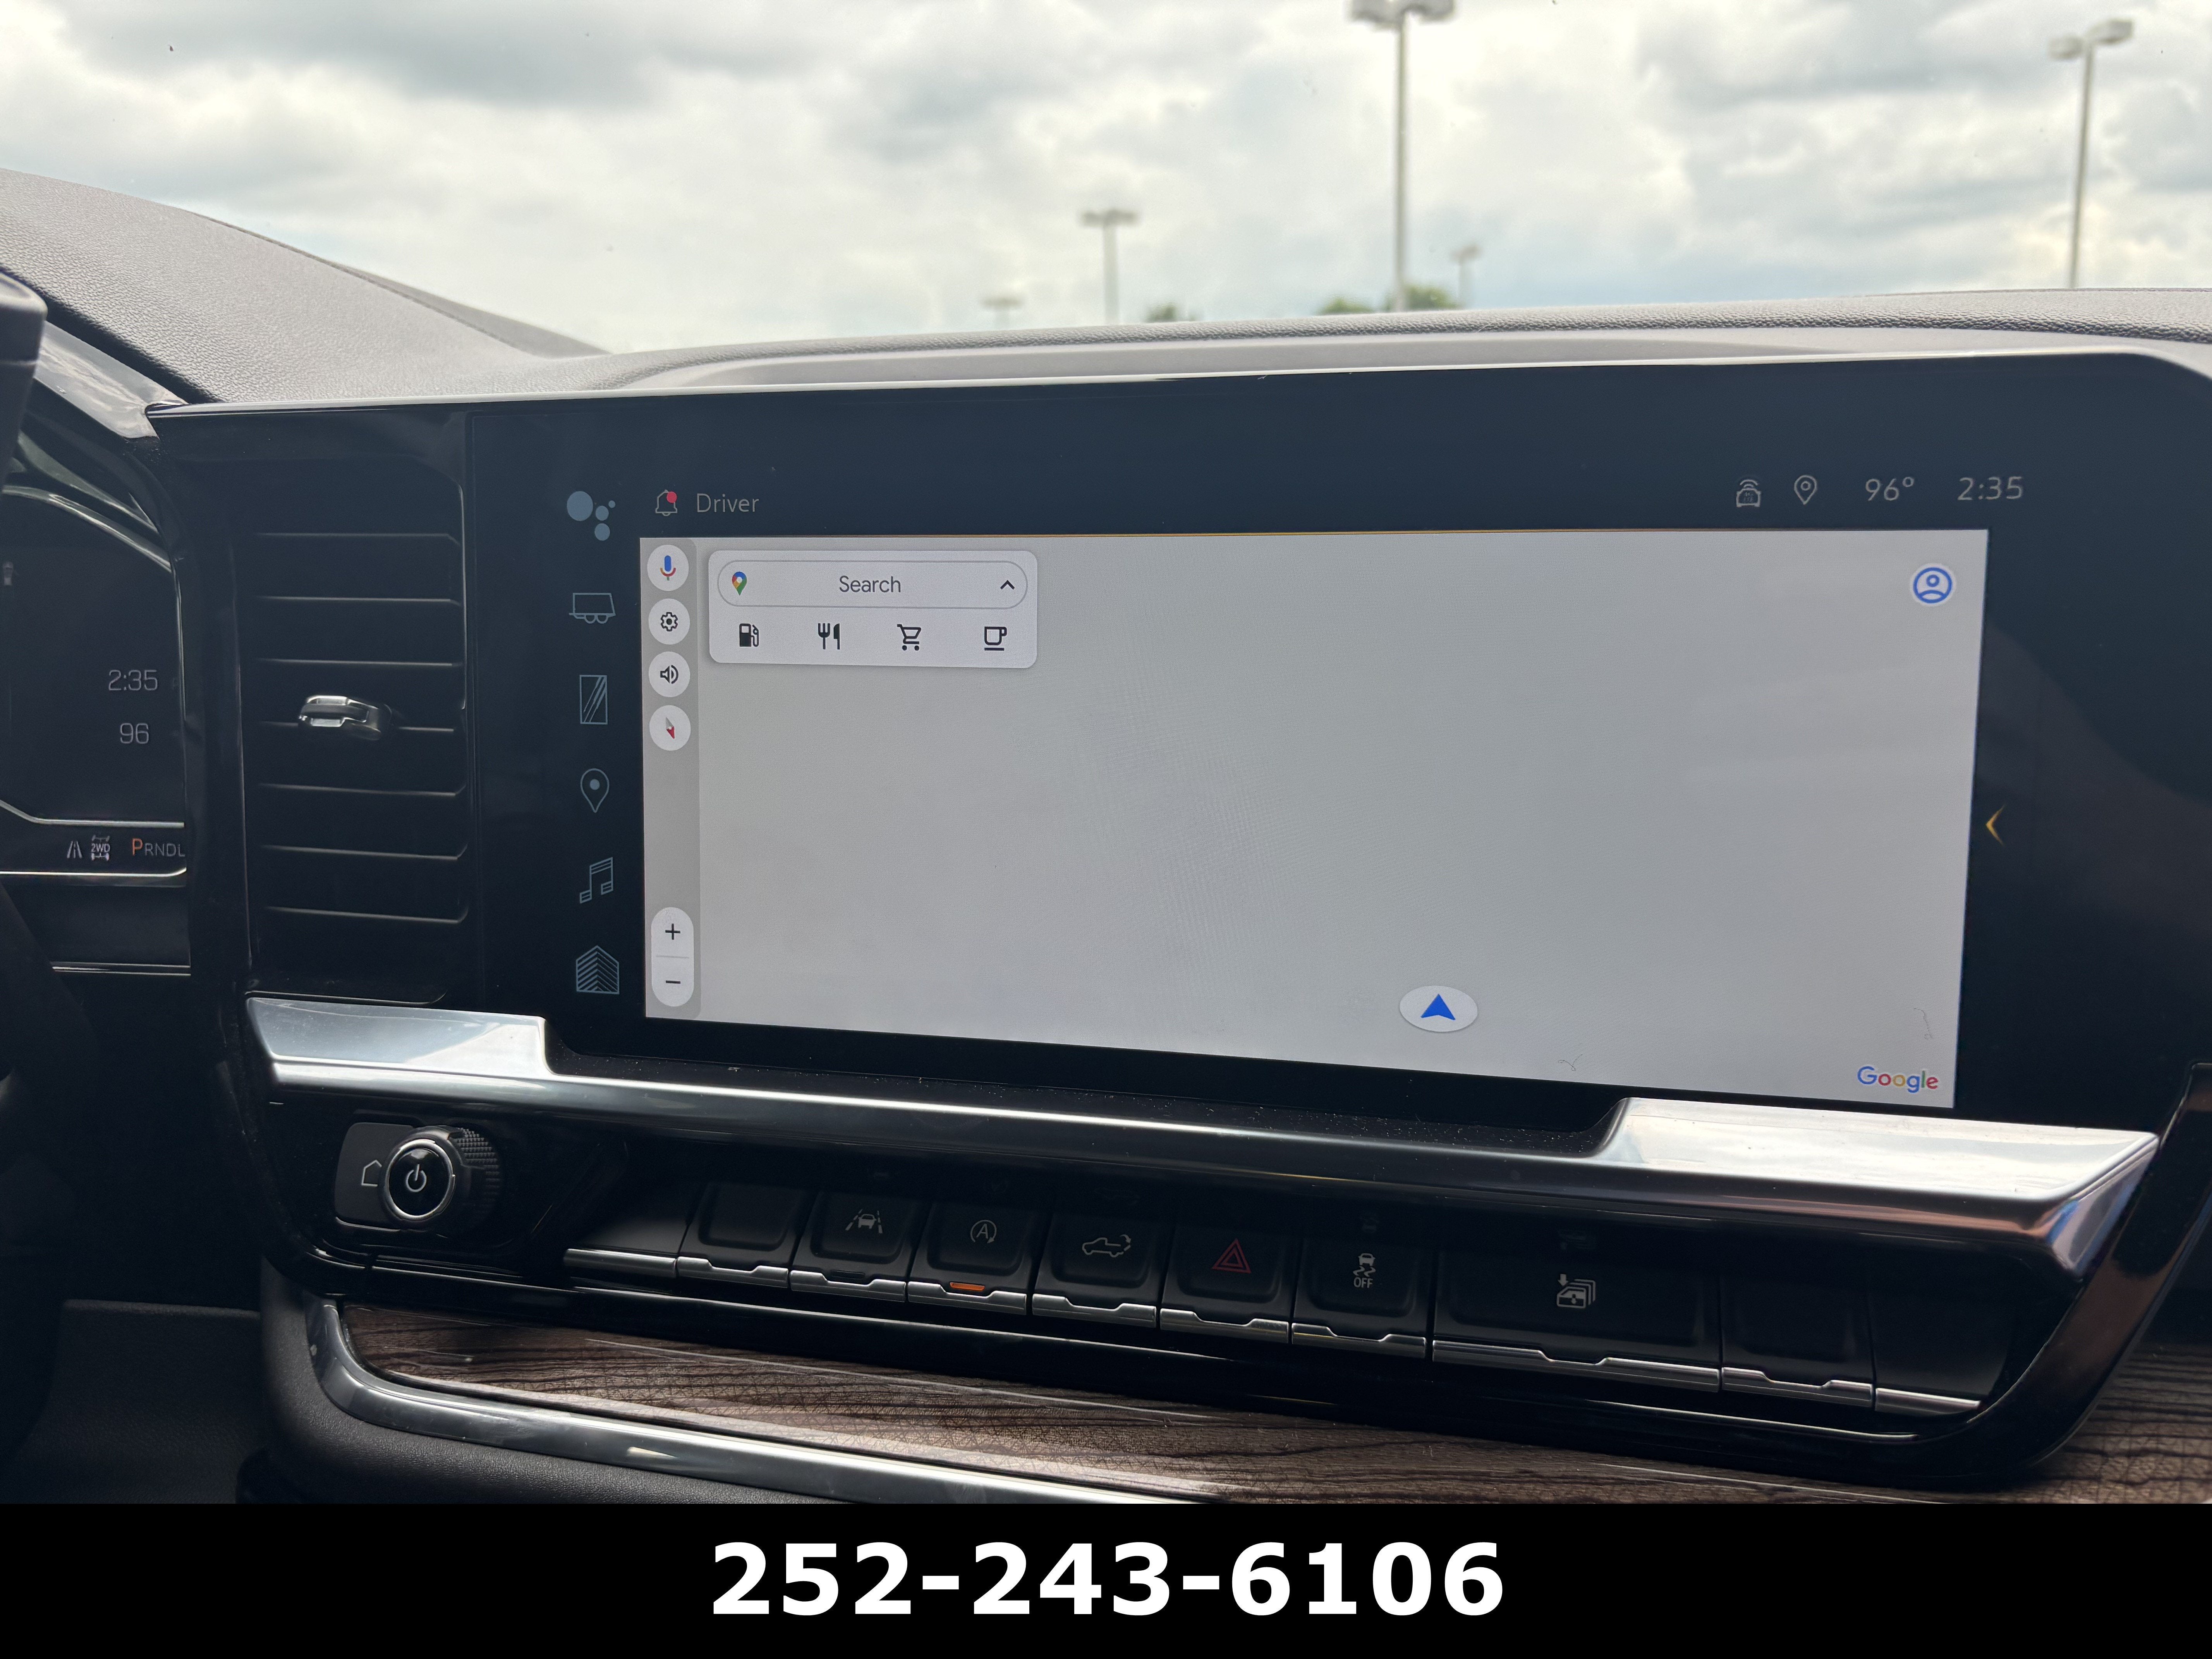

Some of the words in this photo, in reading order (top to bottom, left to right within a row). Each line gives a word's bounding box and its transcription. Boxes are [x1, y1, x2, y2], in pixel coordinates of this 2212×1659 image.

[1957, 476, 2023, 500] 2:35
[697, 493, 759, 512] Driver
[839, 575, 901, 592] Search
[108, 670, 158, 690] 2:35
[120, 723, 149, 744] 96
[91, 843, 110, 852] 2WD
[1857, 1066, 1938, 1093] Google
[976, 1223, 988, 1239] A
[1353, 1277, 1373, 1288] OFF
